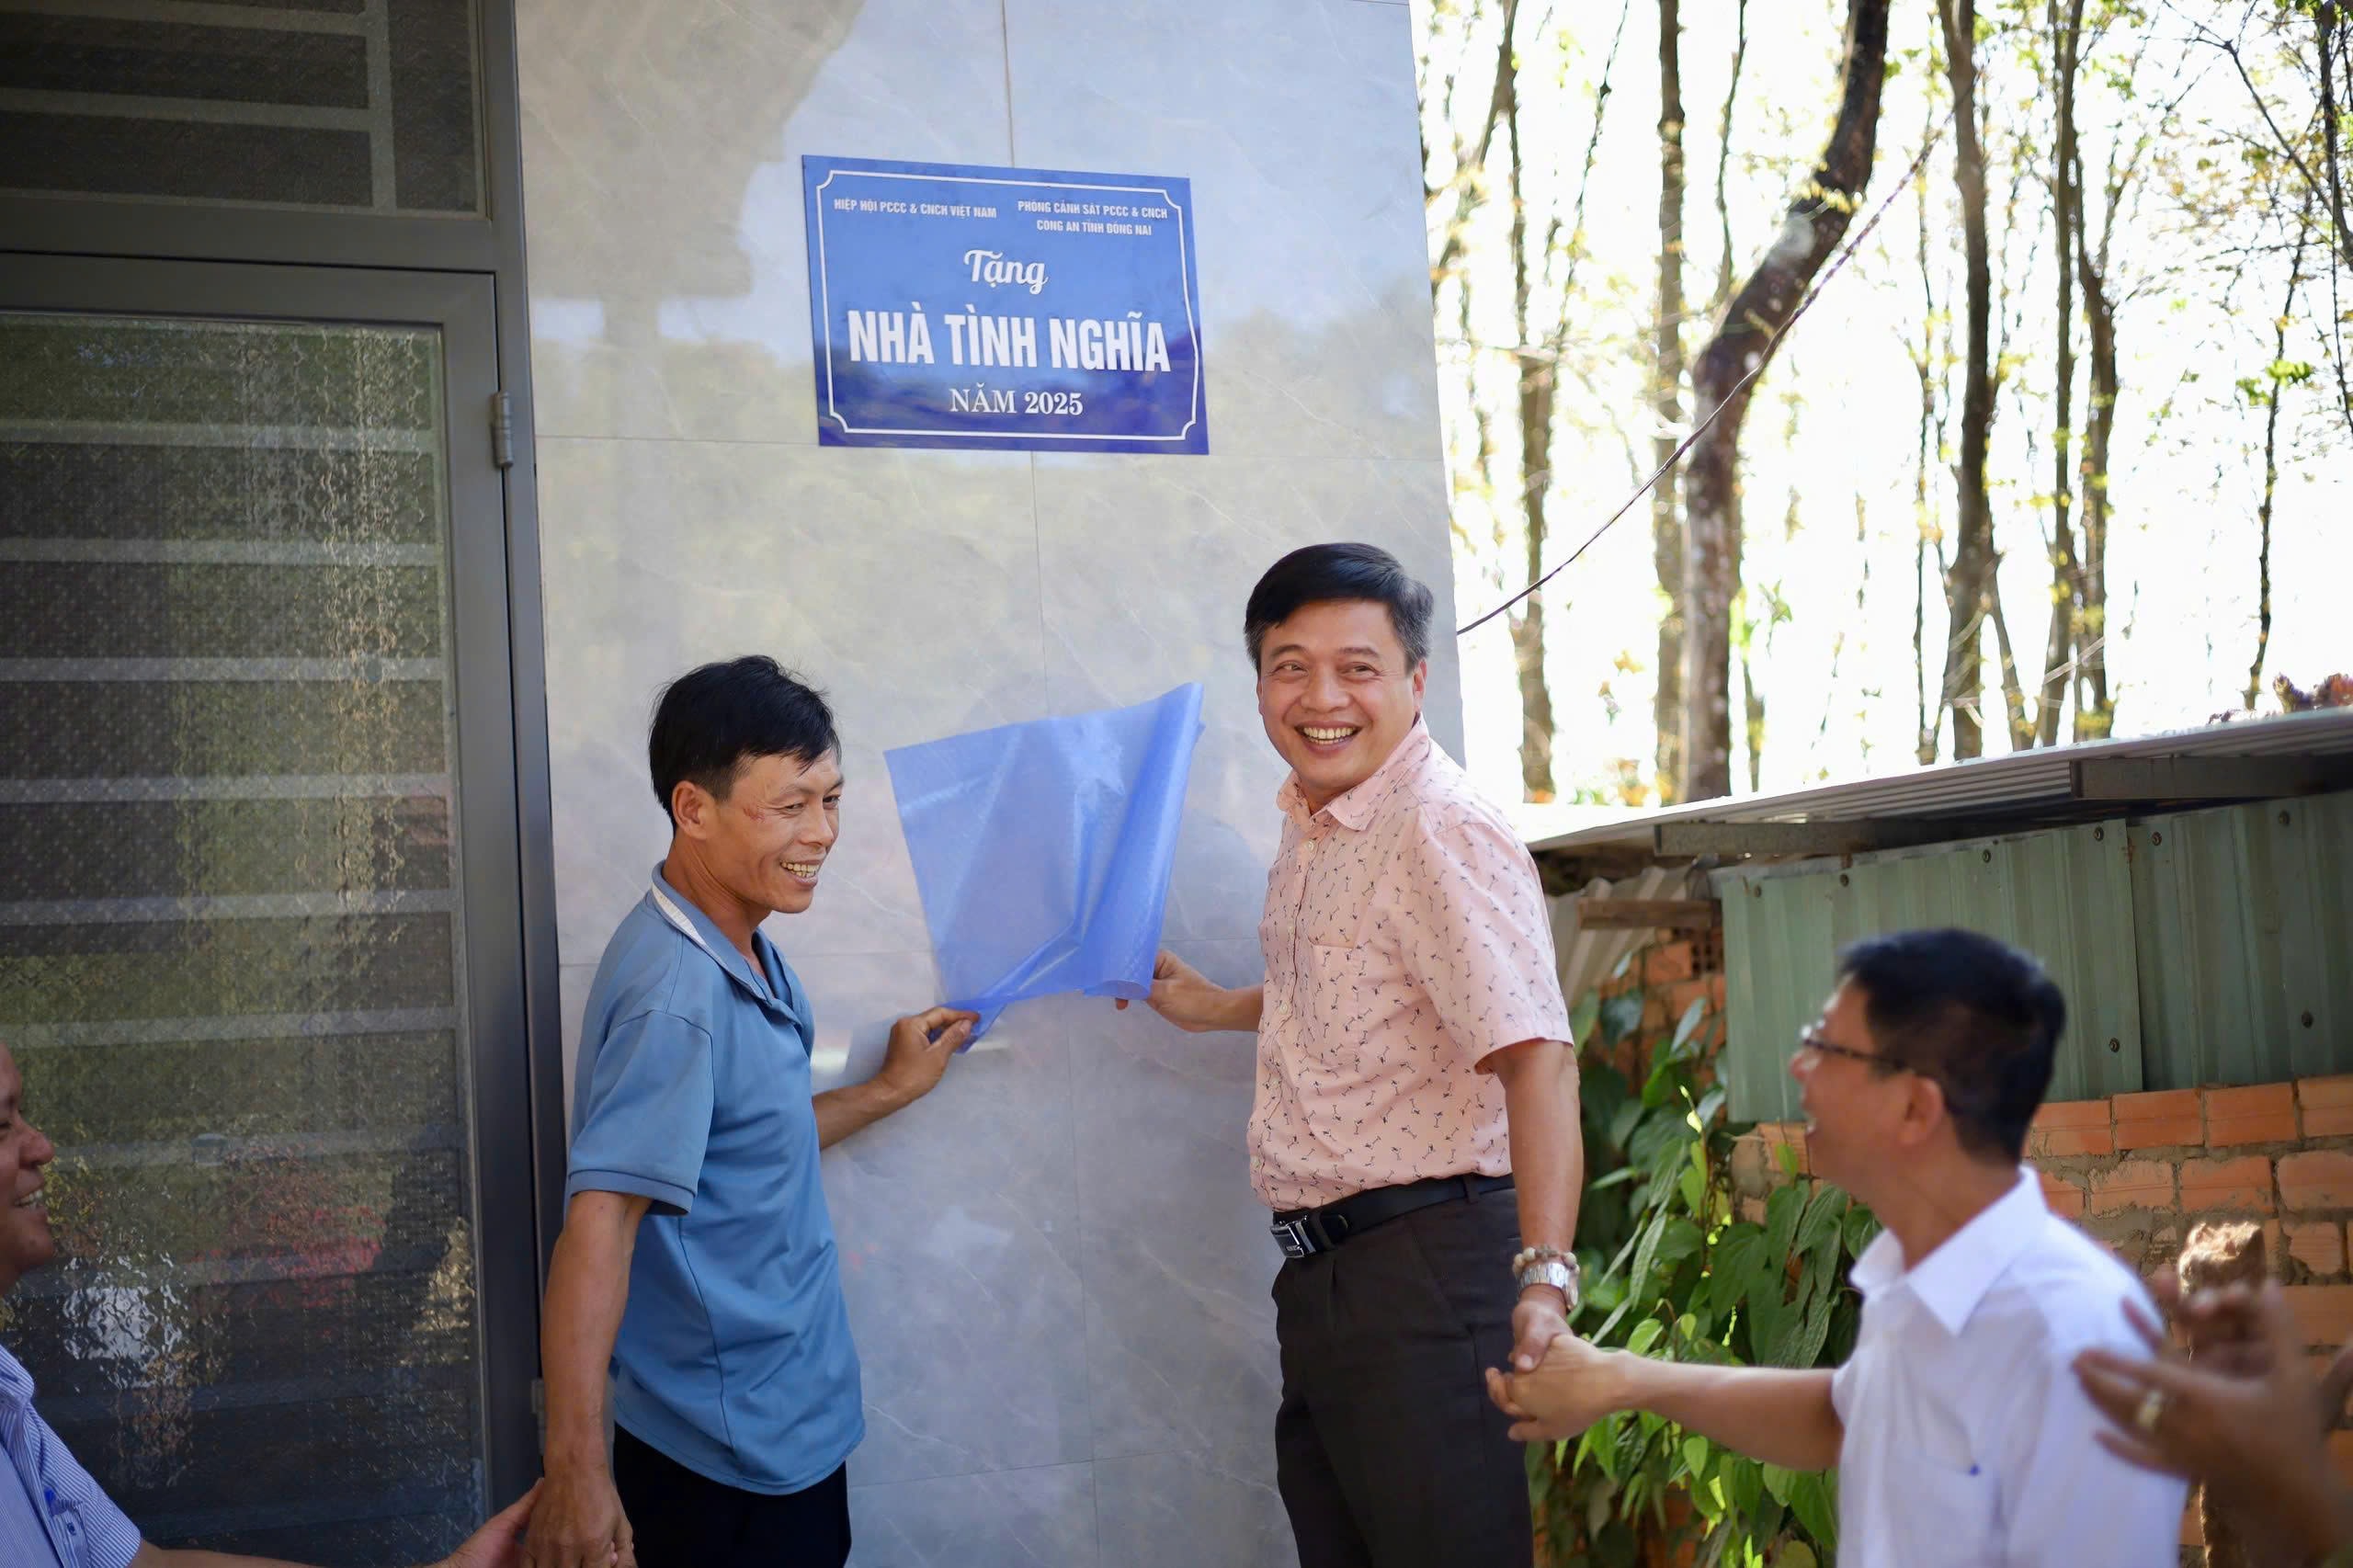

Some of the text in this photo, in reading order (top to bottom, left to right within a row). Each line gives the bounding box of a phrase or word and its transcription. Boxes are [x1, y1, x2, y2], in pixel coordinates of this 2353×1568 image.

[880, 201, 907, 213] PCCC
[910, 203, 917, 214] &
[921, 203, 948, 216] CNCH
[949, 204, 971, 219] VIỆT
[973, 207, 997, 219] NAM
[1083, 202, 1101, 215] SÁT
[1103, 205, 1129, 217] PCCC
[1131, 207, 1139, 217] &
[1142, 207, 1168, 219] CNCH
[1065, 222, 1080, 232] AN
[1135, 225, 1152, 236] NAI
[963, 249, 1049, 295] Tặng
[847, 301, 1171, 372] NHÀ TÌNH NGHĨA
[949, 382, 1084, 415] NĂM 2025
